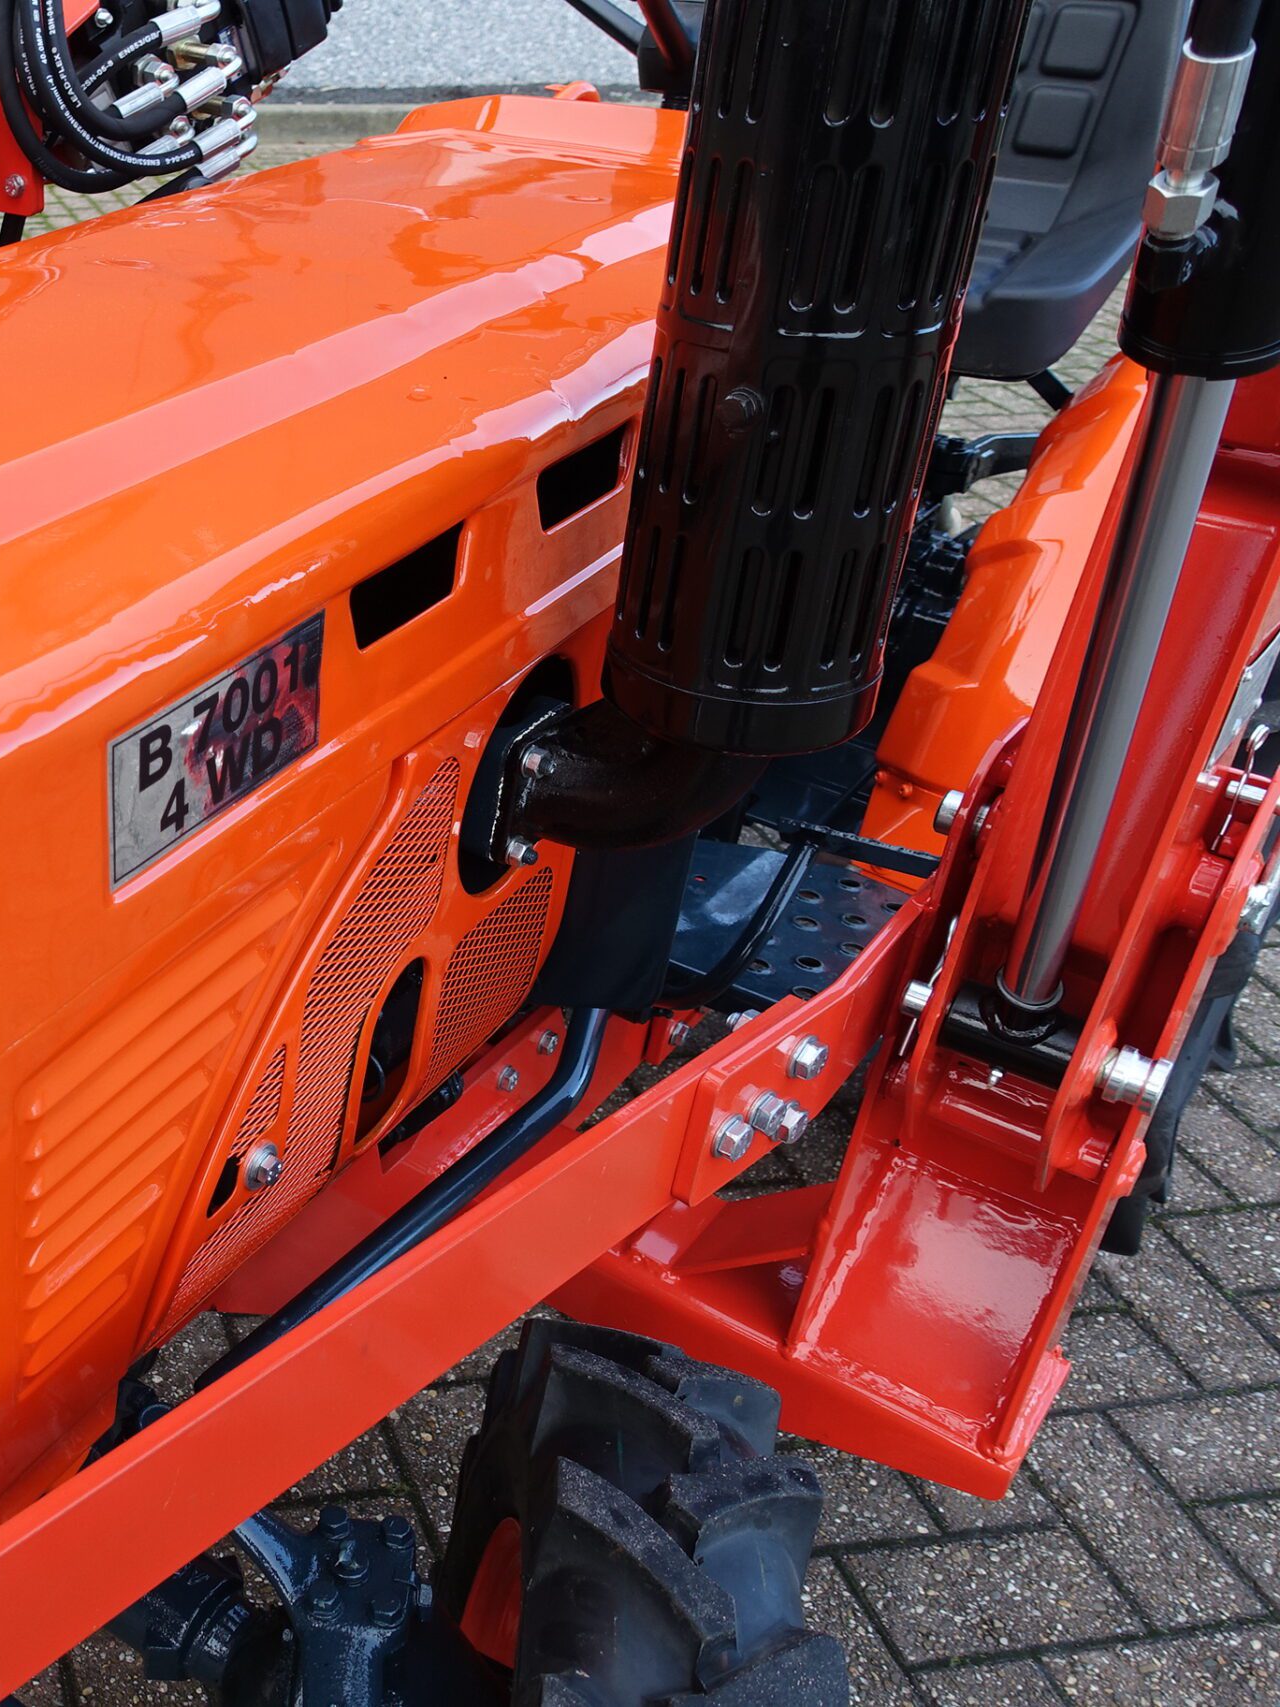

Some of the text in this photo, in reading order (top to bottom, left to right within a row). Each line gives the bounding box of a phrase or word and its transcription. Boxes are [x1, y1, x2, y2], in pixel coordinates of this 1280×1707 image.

[139, 723, 173, 793] B
[159, 716, 283, 833] 4 WD
